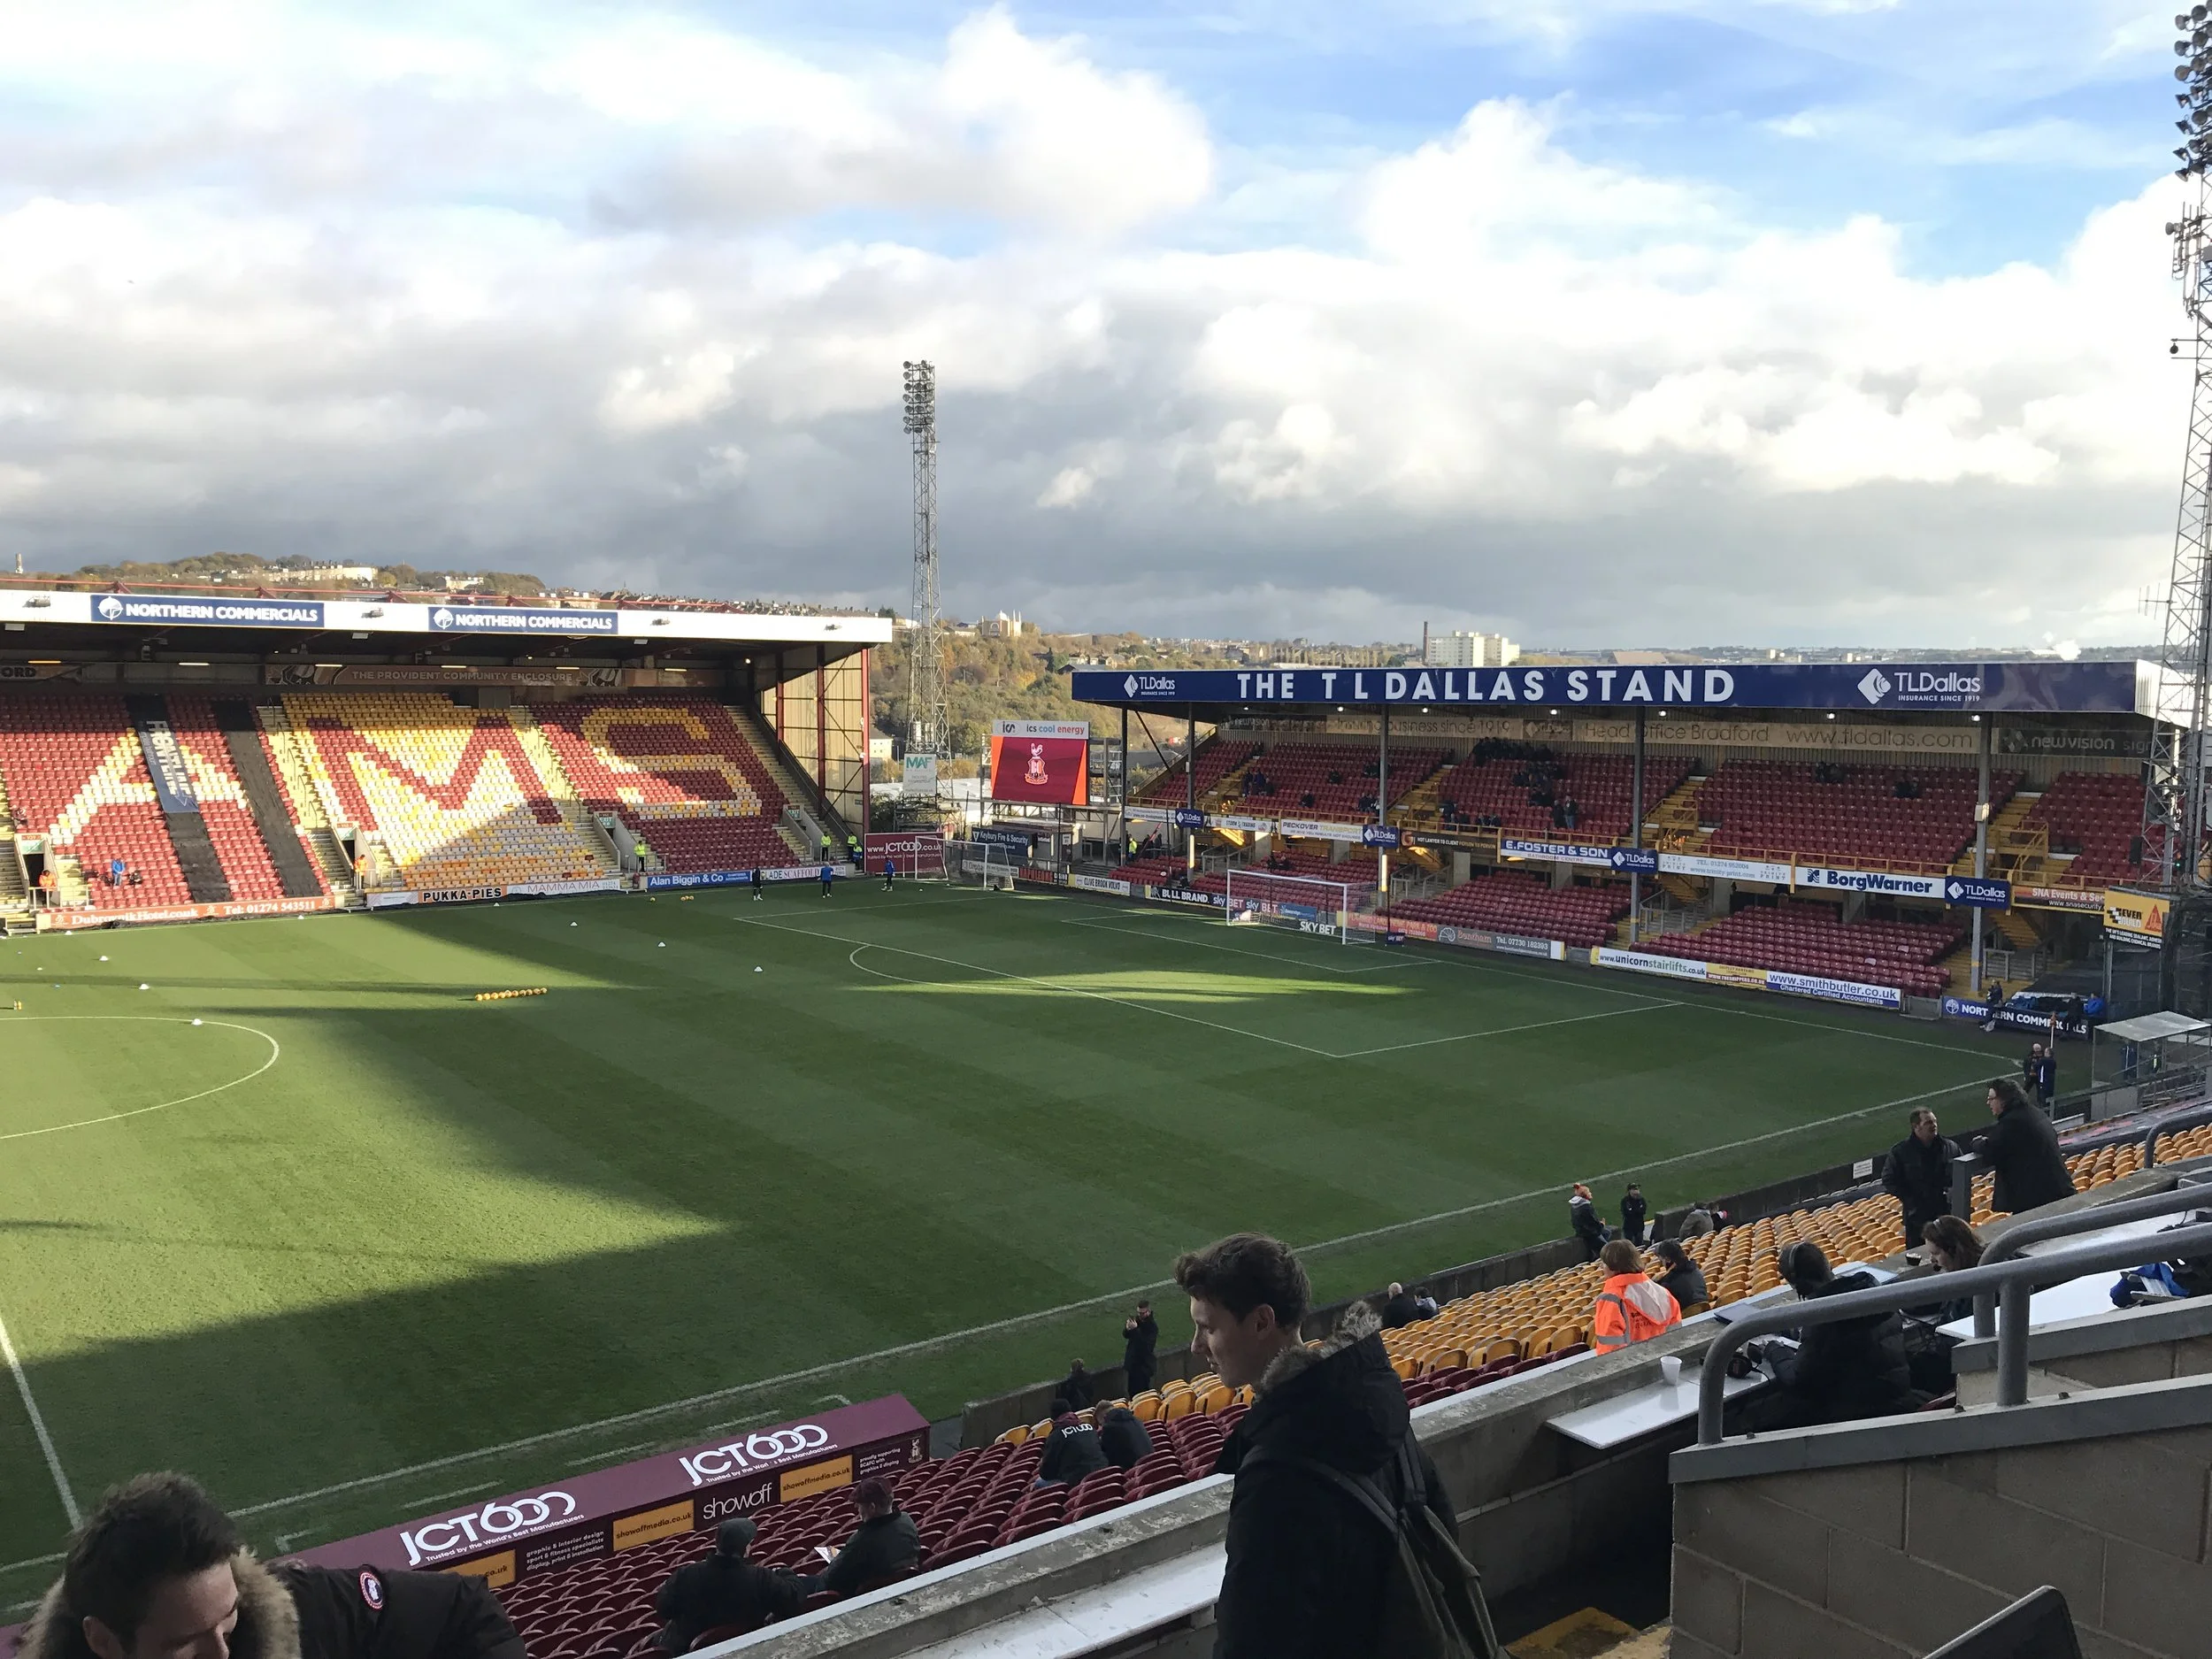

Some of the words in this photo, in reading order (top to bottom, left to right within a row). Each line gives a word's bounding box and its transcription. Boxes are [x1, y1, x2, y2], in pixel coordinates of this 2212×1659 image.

[126, 603, 213, 619] NORTHERN
[215, 605, 318, 621] COMMERCIALS
[456, 613, 526, 627] NORTHERN
[528, 613, 612, 630] COMMERCIALS
[352, 671, 375, 680] THE
[377, 671, 441, 680] PROVIDENT
[442, 672, 509, 681] COMMUNITY
[511, 672, 572, 682] ENCLOSURE
[1139, 676, 1175, 690] TLDallas
[1893, 672, 1981, 693] TLDallas
[1238, 672, 1294, 699] THE
[1322, 672, 1336, 699] T
[1355, 672, 1368, 700] L
[1385, 670, 1544, 701] DALLAS
[1567, 670, 1734, 703] STAND
[1039, 725, 1056, 733] cool
[1056, 726, 1085, 735] energy
[1584, 723, 1630, 738] Head
[1690, 724, 1769, 741] Bradford
[1282, 821, 1318, 831] PECKOVER
[997, 833, 1006, 842] Fire
[1010, 833, 1029, 846] Security
[1567, 846, 1577, 856] &
[1578, 846, 1609, 858] SON
[527, 882, 577, 893] MAMMA
[578, 880, 600, 889] MIA
[649, 875, 672, 887] Alan
[672, 873, 702, 887] Biggin
[702, 873, 710, 883] &
[710, 873, 724, 883] Co
[1095, 879, 1108, 888] BROOK
[1108, 880, 1121, 890] VOLVO
[1826, 871, 1933, 894] BorgWarner
[423, 887, 502, 902] PUKKA-PIES
[1964, 884, 2006, 898] TLDallas
[2032, 887, 2050, 897] SNA
[2051, 888, 2078, 900] Events
[2080, 891, 2087, 901] &
[223, 905, 243, 915] Tel:
[246, 902, 278, 913] 01274
[280, 901, 316, 911] 543511
[1213, 895, 1225, 907] sky
[1229, 898, 1244, 909] BET
[1246, 900, 1259, 911] sky
[1261, 902, 1279, 914] BET
[1299, 920, 1319, 933] SKY
[1318, 925, 1337, 935] BET
[1508, 938, 1526, 947] 07730
[1599, 954, 1706, 976] www.unicornstairlifts.co.uk
[1770, 973, 1897, 1000] www.smithbutler.co.uk
[1779, 983, 1811, 995] Chartered
[1812, 988, 1840, 999] Certified
[1841, 993, 1884, 1005] Accountants
[679, 1424, 829, 1487] JCT600
[706, 1473, 732, 1483] Trusted
[732, 1470, 741, 1479] by
[791, 1443, 839, 1461] Manufacturers
[782, 1466, 850, 1492] showoffmedia.co.uk
[703, 1482, 773, 1521] showoff
[400, 1491, 576, 1567] JCT600
[616, 1511, 693, 1540] showoffmedia.co.uk
[426, 1549, 455, 1563] Trusted
[456, 1546, 468, 1555] by
[468, 1541, 483, 1550] the
[483, 1533, 512, 1547] World's
[512, 1528, 529, 1539] Best
[530, 1514, 585, 1534] Manufacturers
[526, 1545, 551, 1558] graphic
[558, 1536, 582, 1547] interior
[583, 1530, 604, 1540] design
[526, 1554, 543, 1564] sport
[549, 1547, 571, 1557] fitness
[572, 1537, 604, 1552] specialists
[526, 1559, 551, 1571] display,
[551, 1554, 566, 1564] print
[572, 1544, 604, 1558] installation
